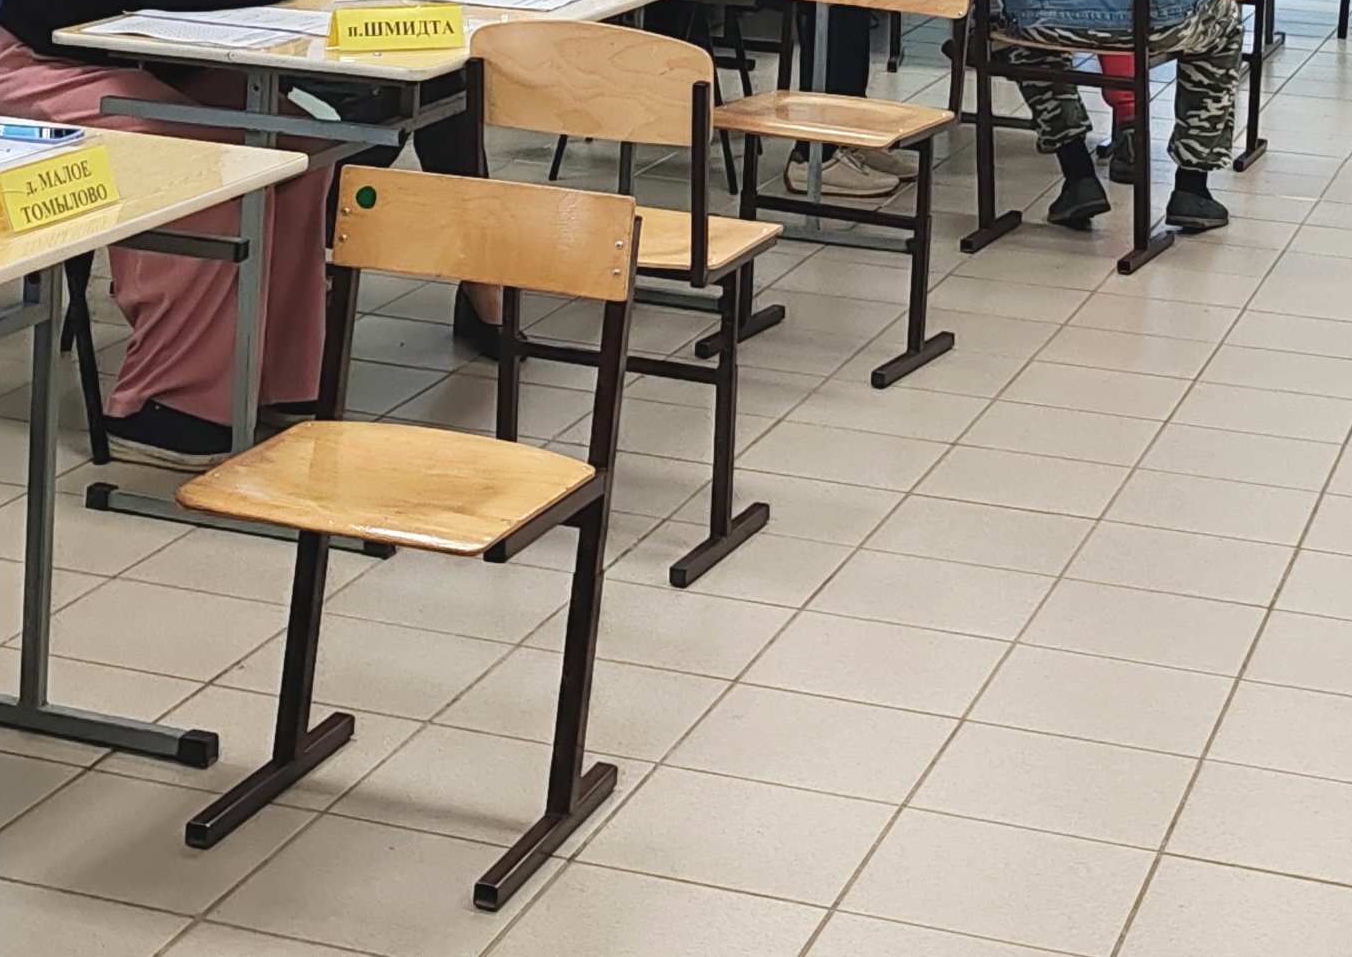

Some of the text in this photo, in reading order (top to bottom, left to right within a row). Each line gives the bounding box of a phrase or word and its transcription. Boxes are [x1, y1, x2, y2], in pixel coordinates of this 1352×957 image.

[348, 20, 455, 38] п.ШМИДТА
[26, 159, 92, 197] д. МАЛОЕ
[20, 183, 108, 224] ТОМЫЛОВО
